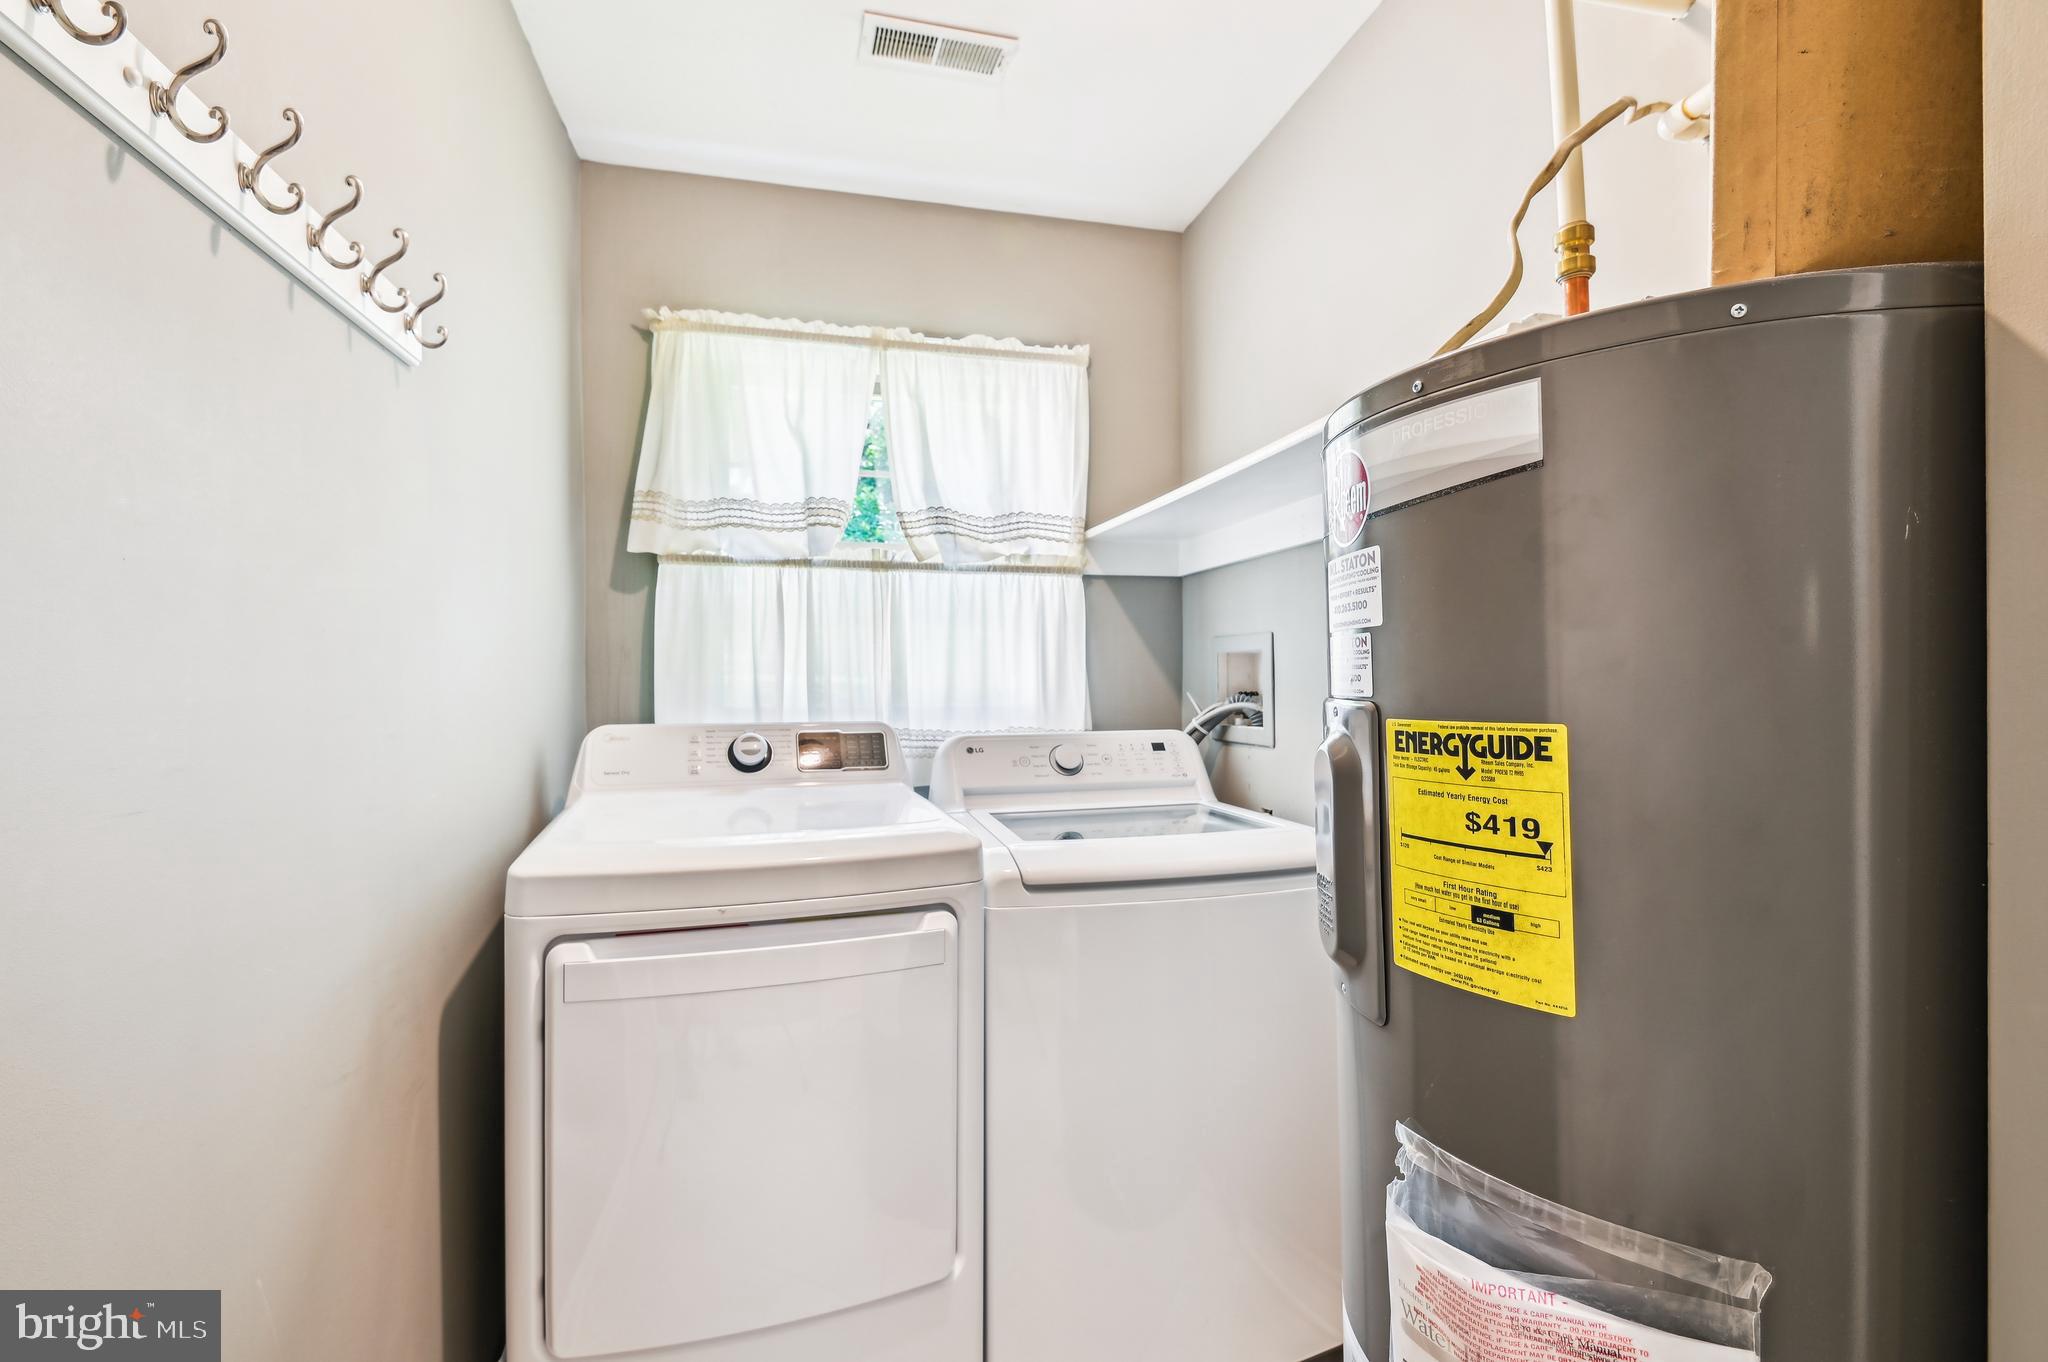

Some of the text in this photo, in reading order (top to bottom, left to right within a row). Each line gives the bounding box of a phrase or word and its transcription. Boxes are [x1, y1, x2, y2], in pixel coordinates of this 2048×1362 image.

[1341, 550, 1376, 573] STATON
[1394, 729, 1553, 762] ENERGYGUIDE
[1418, 788, 1508, 805] Estimated Yearly Energy Cost
[1465, 811, 1541, 840] $419
[1443, 856, 1456, 864] Range
[1461, 859, 1477, 867] Similar
[1478, 862, 1495, 870] Models
[1443, 880, 1498, 899] First Hour Rating
[1482, 897, 1490, 905] first
[1491, 899, 1502, 907] hour
[1482, 918, 1500, 927] Gallons
[1530, 921, 1541, 929] high
[1471, 1278, 1556, 1307] IMPORTANT
[1457, 1293, 1503, 1320] INSTRUCTIONS
[1521, 1318, 1561, 1329] WARRANTY
[1569, 1326, 1580, 1334] DO
[1581, 1328, 1596, 1337] NOT
[1598, 1331, 1633, 1345] DESTROY
[1468, 1294, 1502, 1311] CONTAINS
[1555, 1315, 1586, 1327] MANUAL
[1588, 1320, 1607, 1331] WITH
[1478, 1338, 1527, 1357] REPLACEMENT
[1529, 1350, 1545, 1359] MAY
[1597, 1339, 1636, 1355] ADJACENT
[1639, 1350, 1649, 1358] TO
